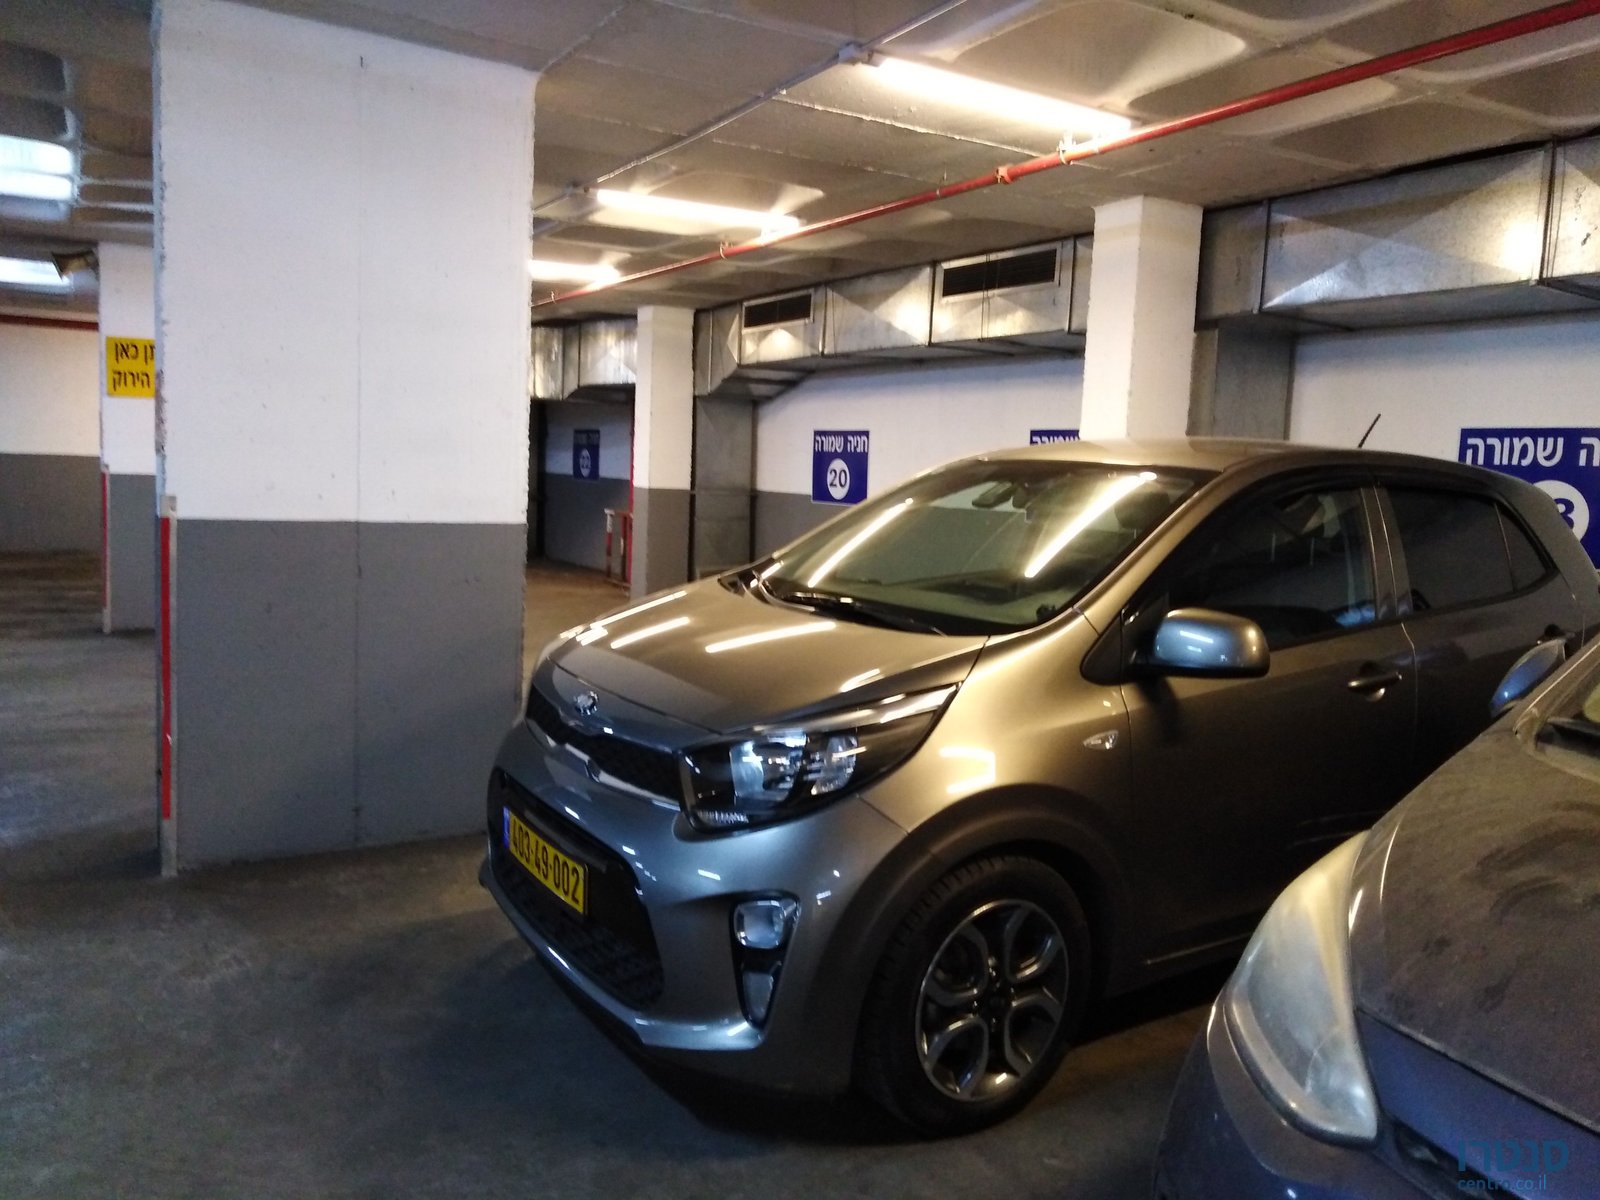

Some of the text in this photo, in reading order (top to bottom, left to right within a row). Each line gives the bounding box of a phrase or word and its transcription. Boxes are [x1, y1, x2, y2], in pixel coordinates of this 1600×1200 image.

[115, 342, 139, 364] כאן
[112, 370, 151, 392] הירוק
[814, 435, 868, 453] חניה שמורה
[1465, 436, 1564, 468] שמורה
[829, 468, 848, 488] 20
